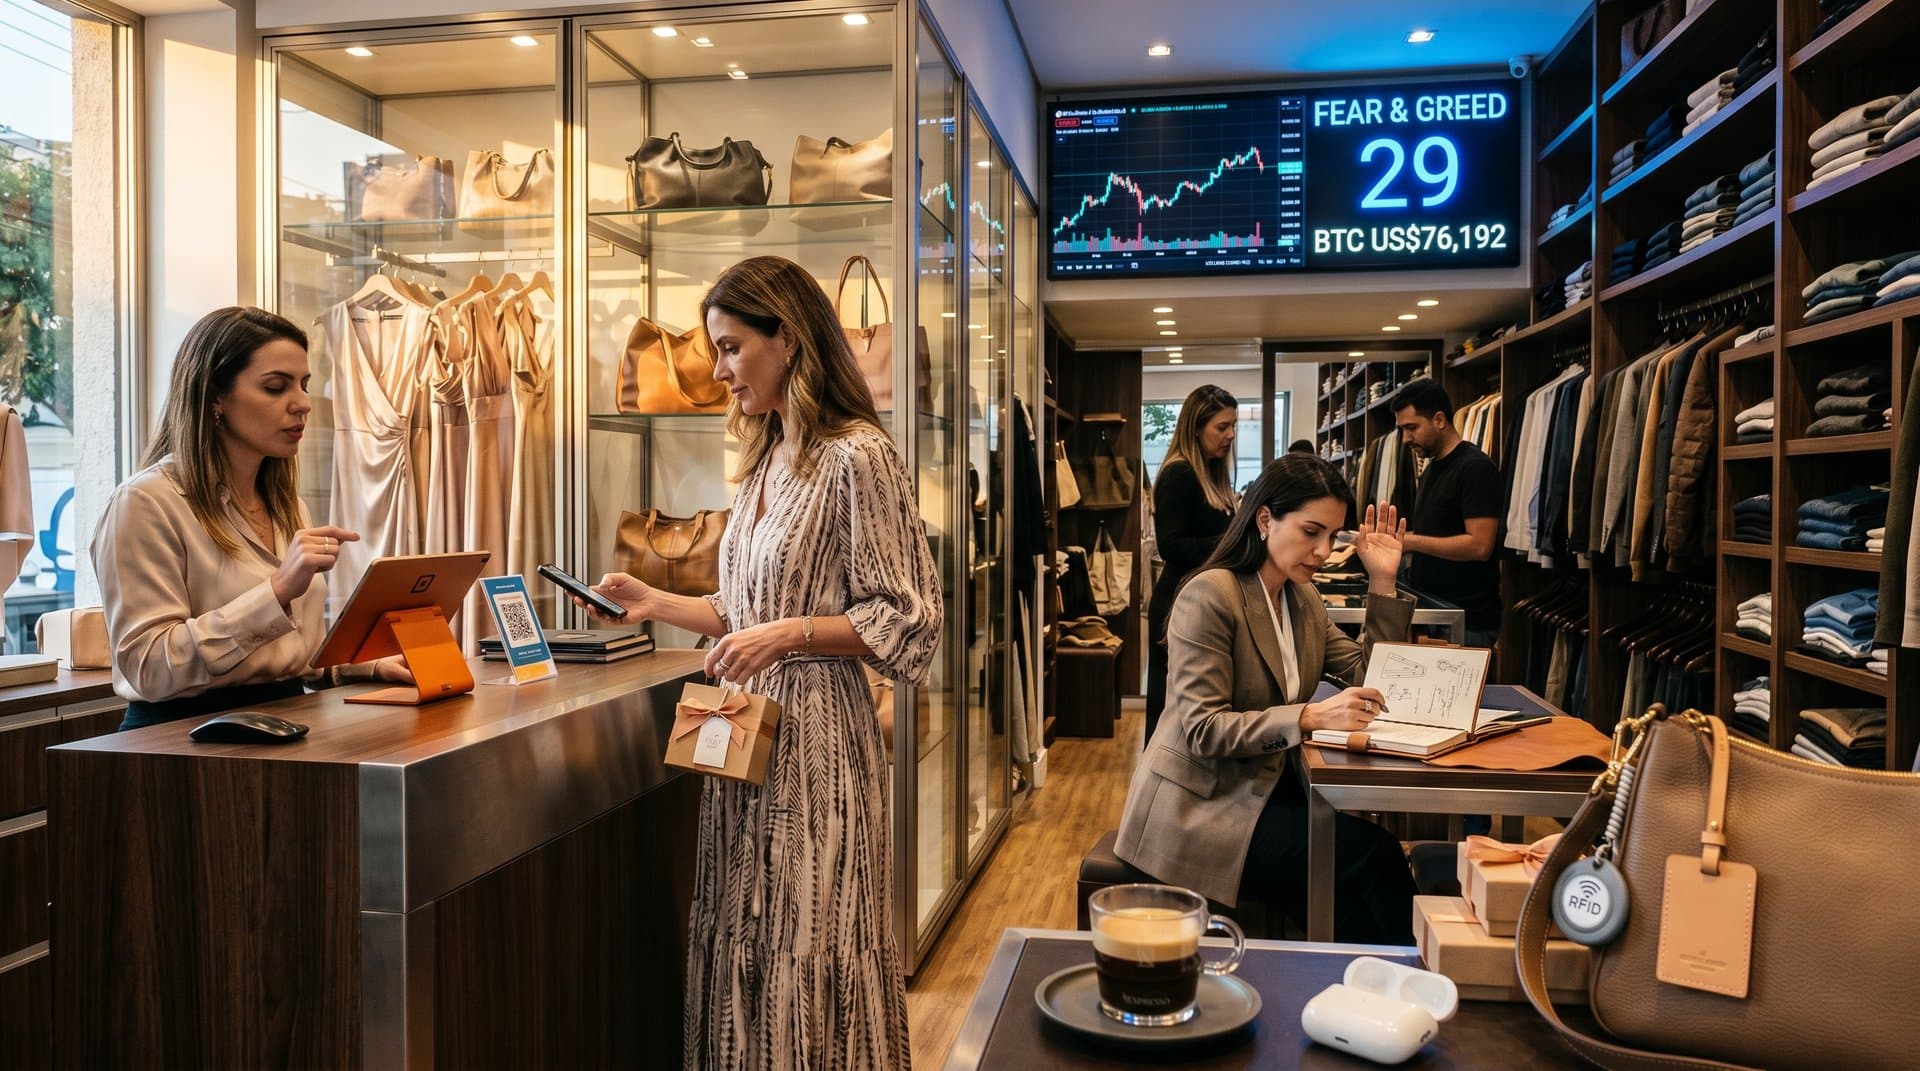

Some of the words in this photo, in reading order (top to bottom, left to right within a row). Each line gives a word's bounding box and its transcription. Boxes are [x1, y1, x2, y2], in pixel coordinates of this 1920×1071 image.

[1314, 99, 1383, 127] FEAR
[1390, 97, 1409, 123] &
[1416, 93, 1507, 122] GREED
[1360, 136, 1459, 209] 29
[1314, 229, 1364, 253] BTC
[1371, 224, 1507, 254] US$76,192
[1568, 895, 1601, 916] RFID
